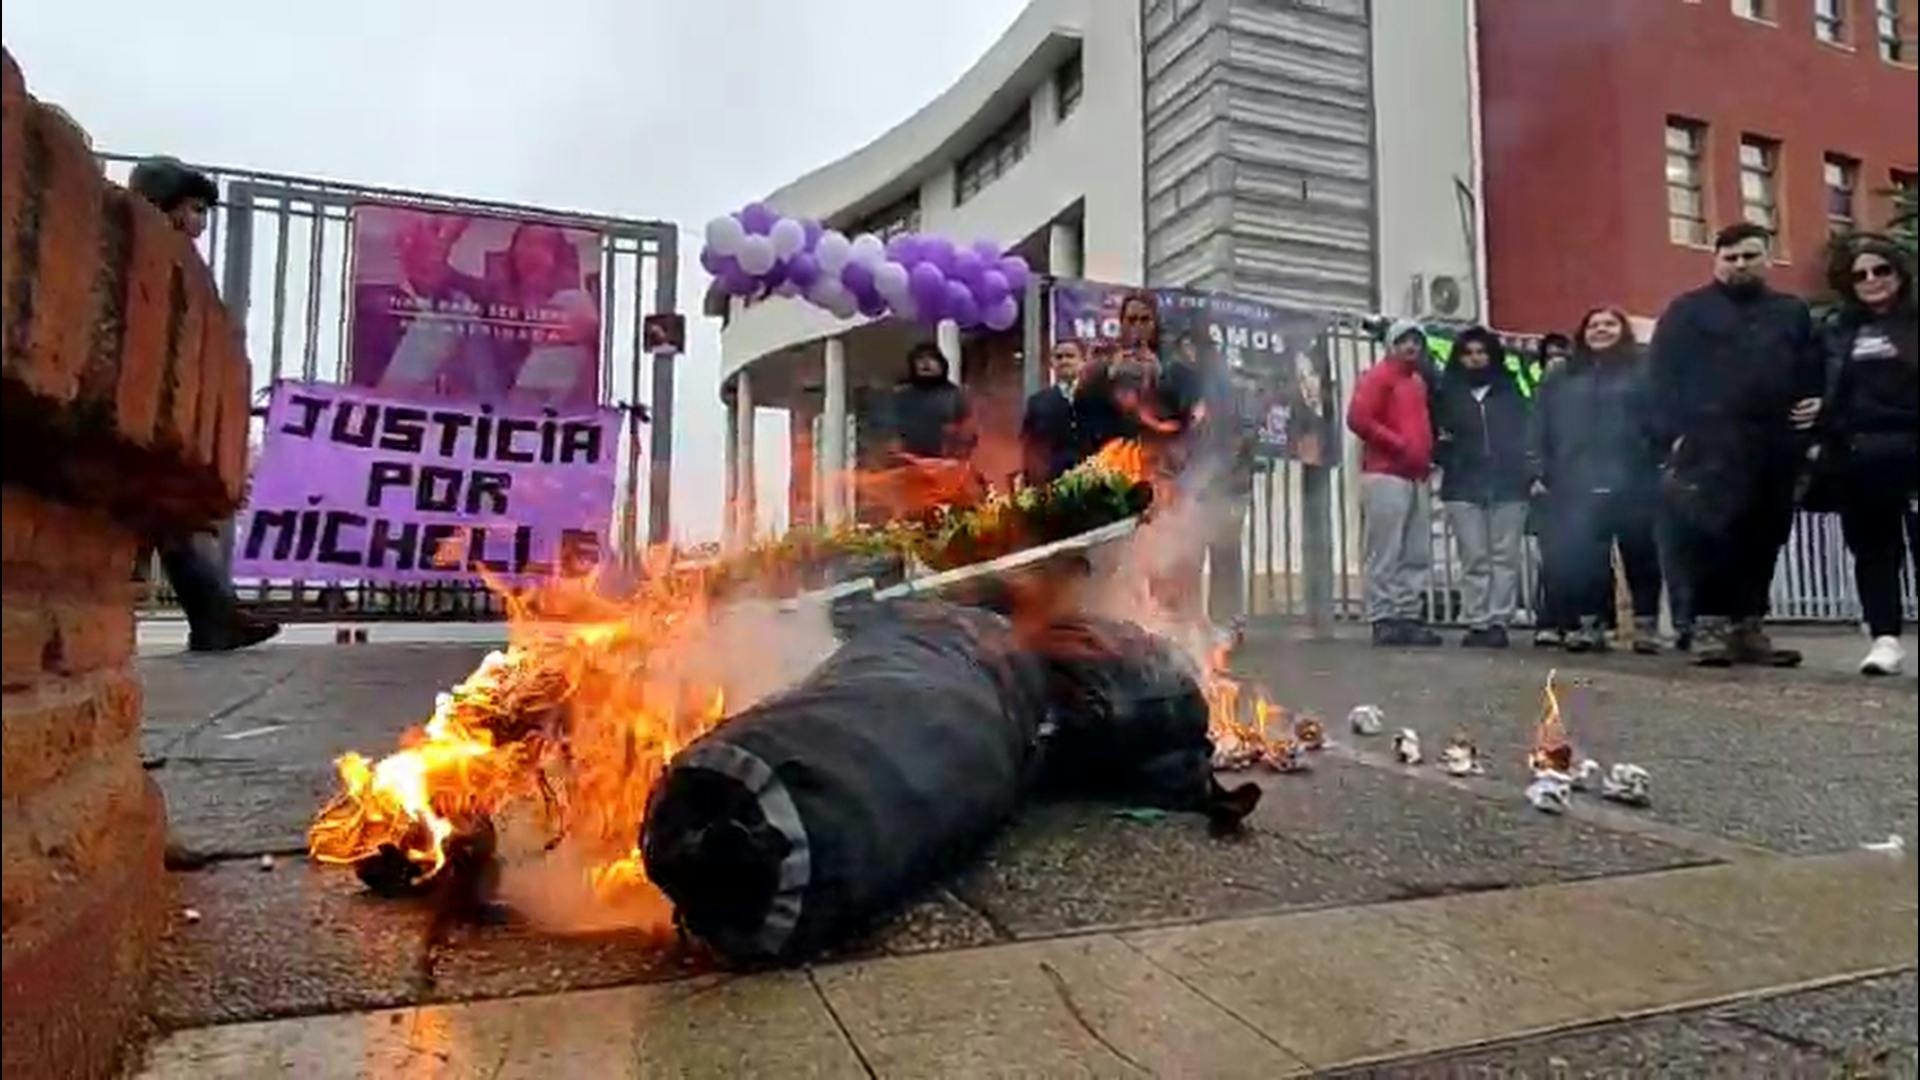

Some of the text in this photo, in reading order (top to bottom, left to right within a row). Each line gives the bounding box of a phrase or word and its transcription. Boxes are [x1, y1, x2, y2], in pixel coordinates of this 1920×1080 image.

[1073, 317, 1121, 339] NO
[281, 394, 601, 464] JUSTICIA
[366, 461, 512, 515] POR
[244, 494, 600, 578] MICHELLE
